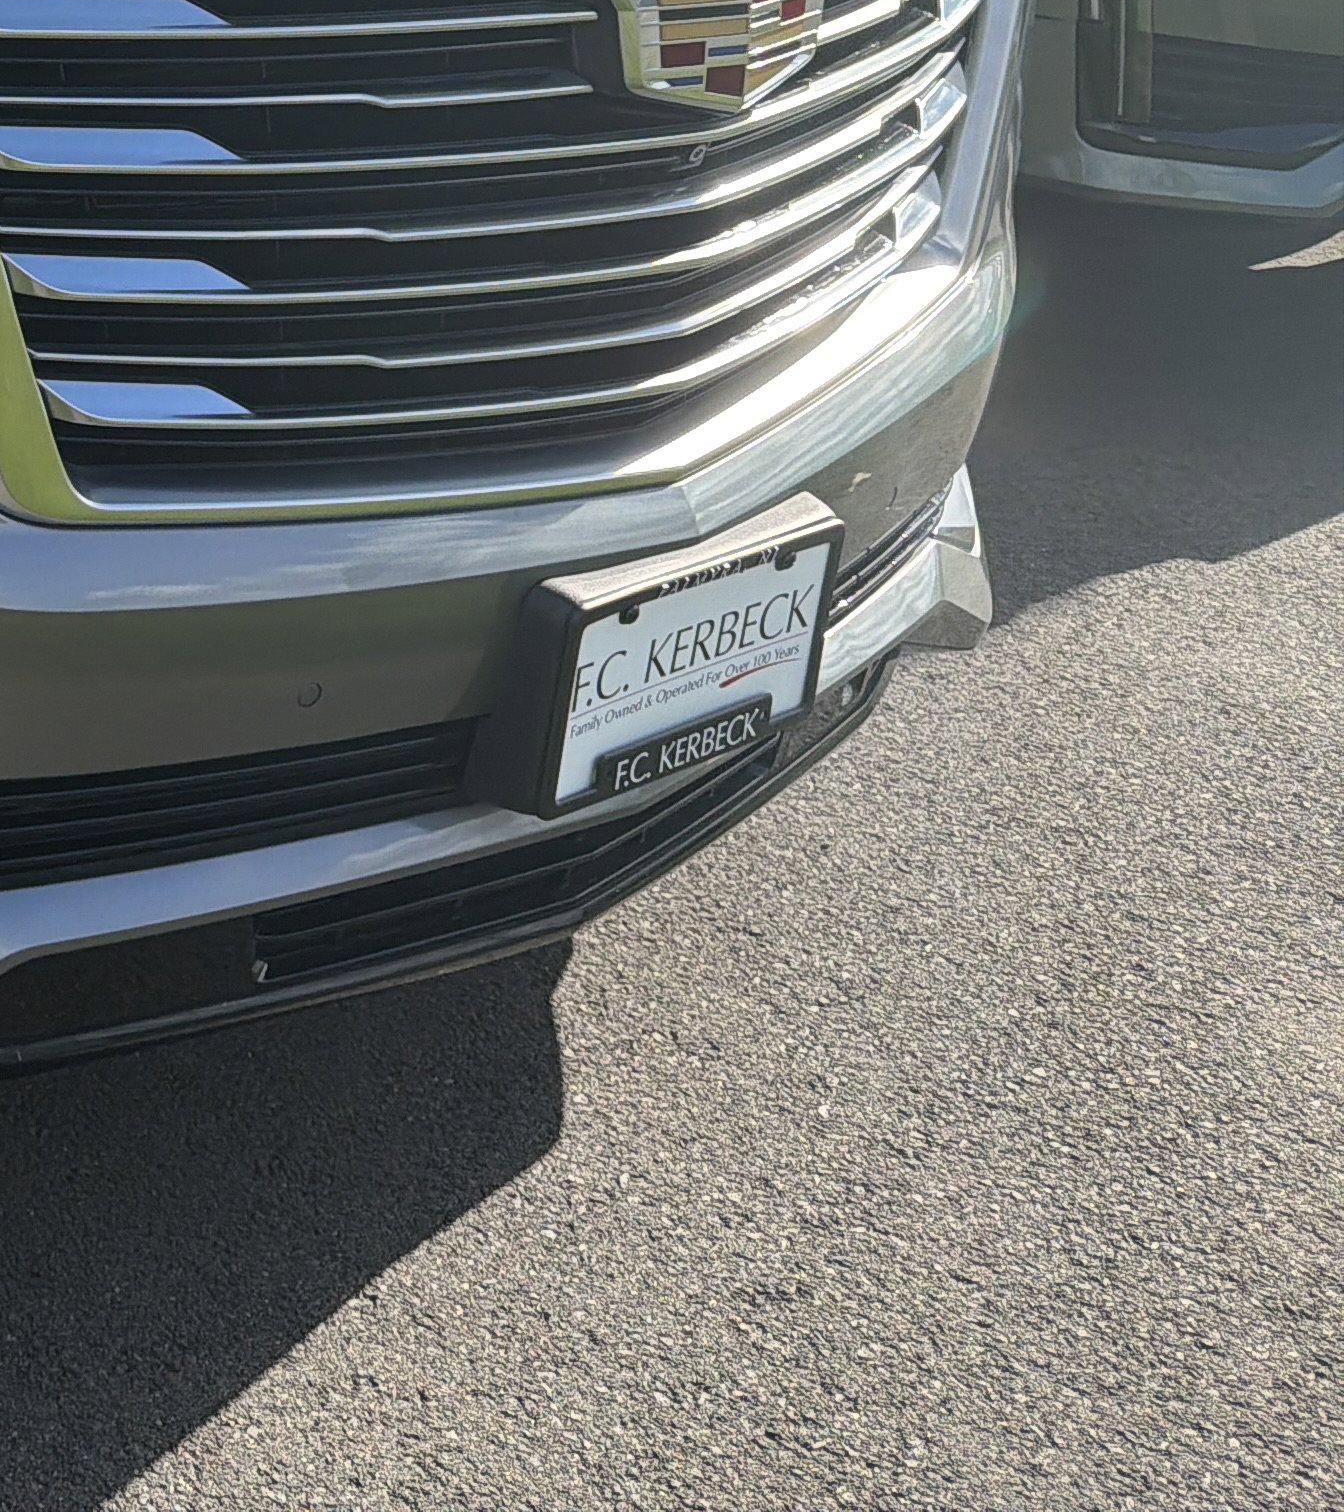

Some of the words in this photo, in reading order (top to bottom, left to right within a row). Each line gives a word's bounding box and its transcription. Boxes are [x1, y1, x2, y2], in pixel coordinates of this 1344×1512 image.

[570, 714, 603, 740] Family
[604, 700, 643, 725] Owned
[644, 694, 653, 708] &
[655, 673, 705, 704] Operated
[705, 670, 723, 687] For
[724, 660, 750, 678] Over
[752, 651, 772, 668] 100
[773, 643, 800, 662] Years
[571, 649, 630, 714] F.C.
[643, 583, 815, 684] KERBECK
[614, 751, 652, 791] F.C.
[658, 707, 760, 774] KERBECK
